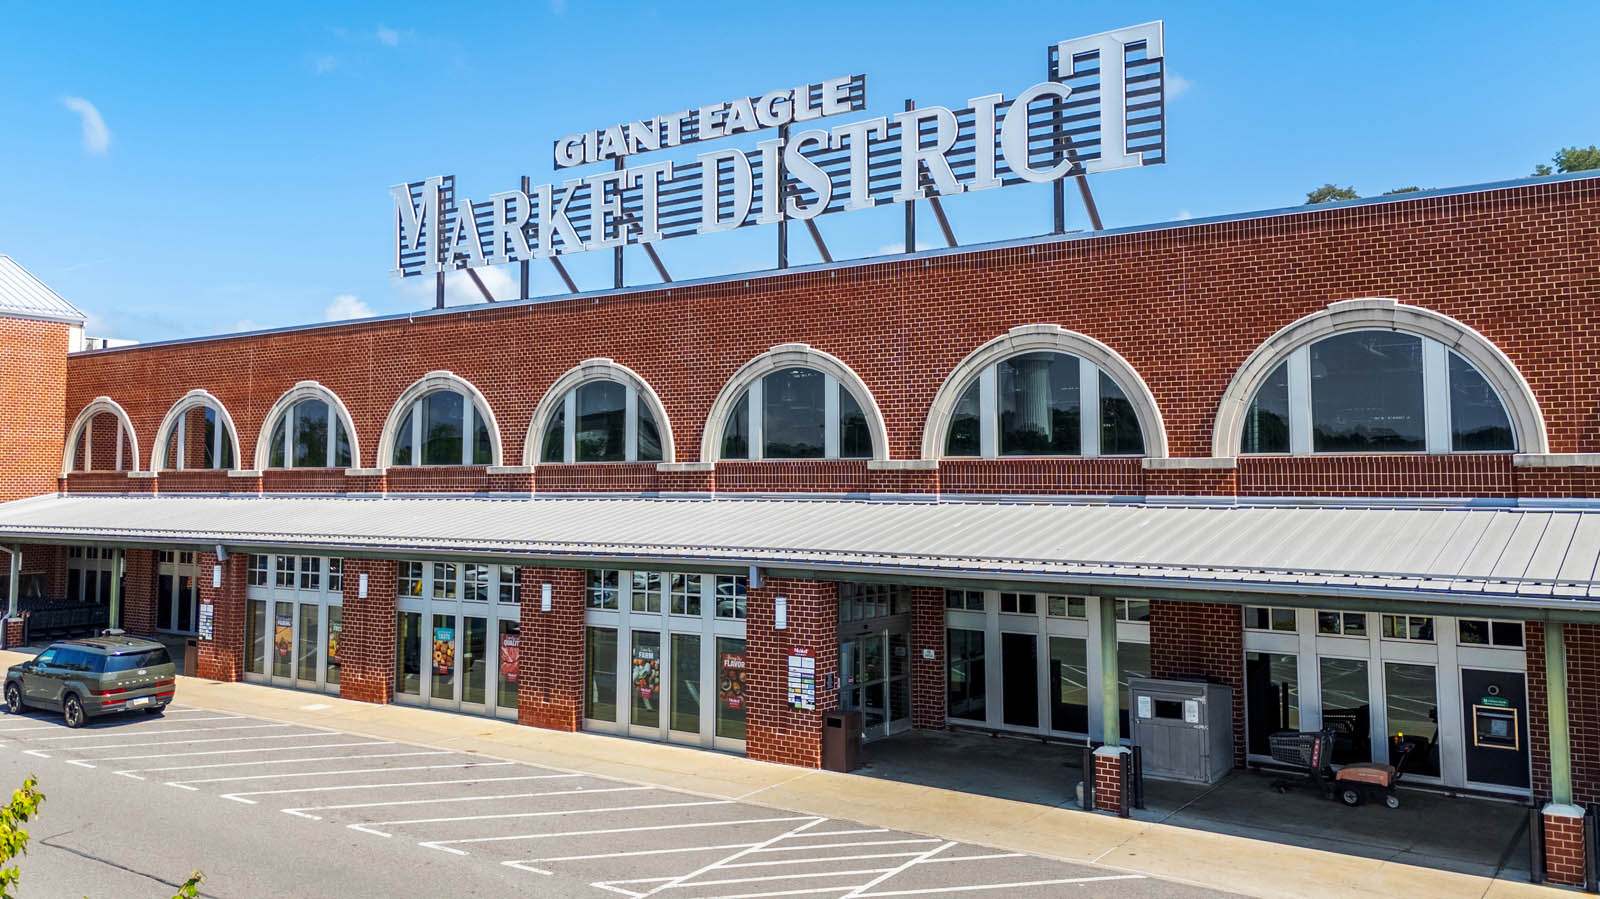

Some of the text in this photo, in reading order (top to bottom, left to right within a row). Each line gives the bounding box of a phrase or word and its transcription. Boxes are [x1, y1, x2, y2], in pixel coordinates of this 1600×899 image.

[389, 20, 1164, 279] MARKET DISTRICT
[555, 74, 852, 168] GIANT EAGLE
[503, 639, 520, 647] QUALIT
